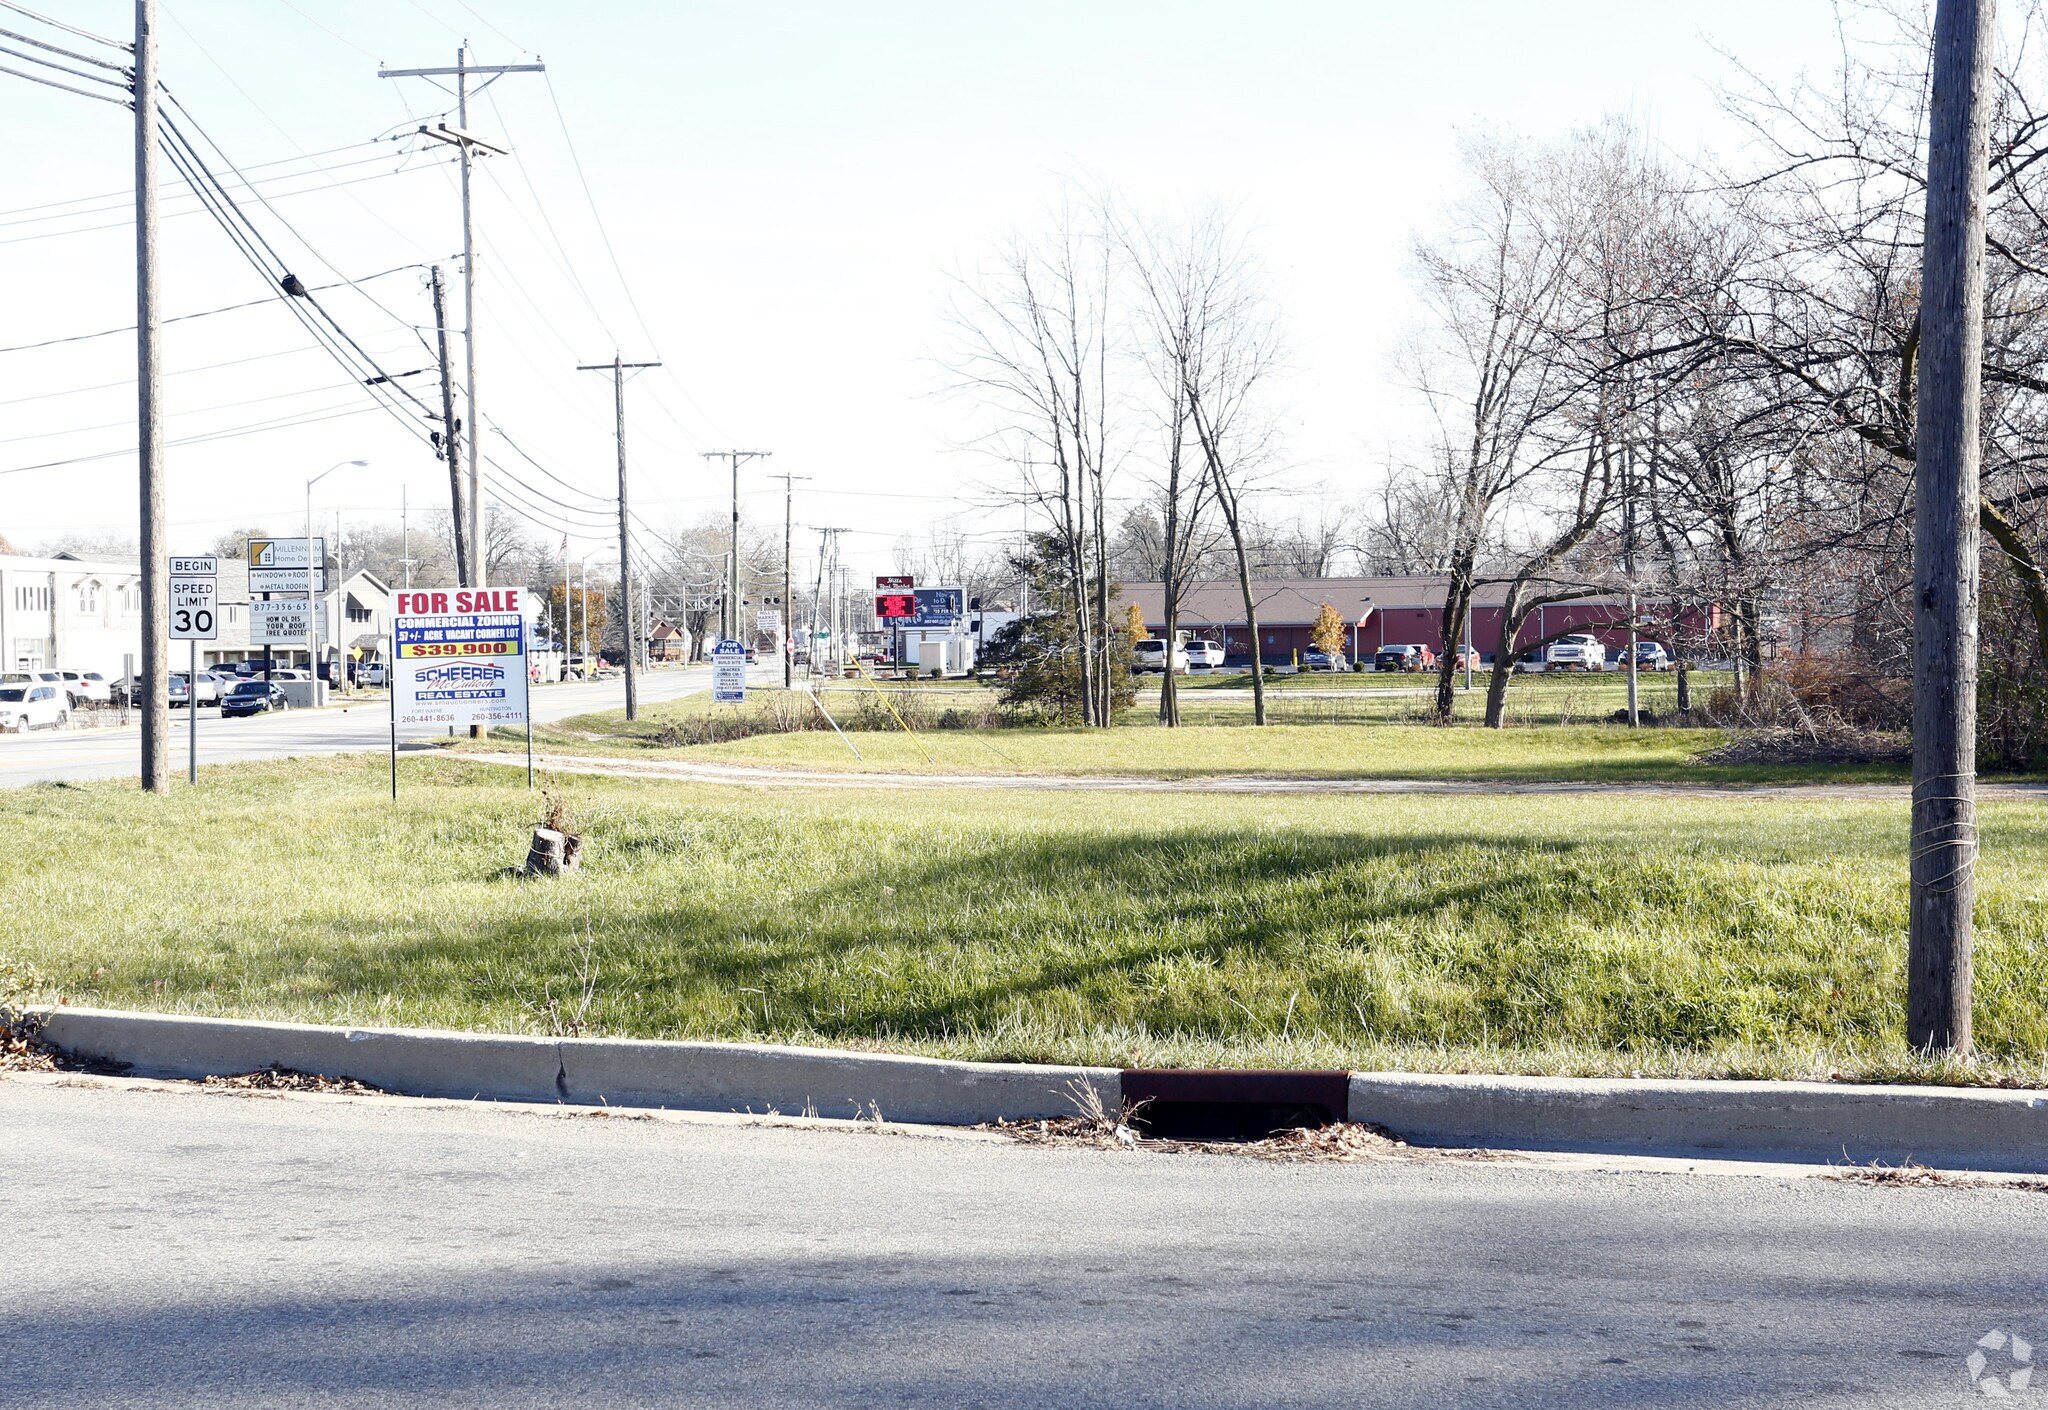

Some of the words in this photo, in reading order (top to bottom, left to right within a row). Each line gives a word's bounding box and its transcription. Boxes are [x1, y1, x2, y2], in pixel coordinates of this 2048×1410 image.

[297, 555, 322, 563] Degn
[175, 561, 212, 571] BEGIN
[173, 584, 213, 594] SPEED
[177, 597, 209, 606] LIMIT
[254, 603, 319, 611] 877-356-656
[397, 592, 448, 615] FOR
[455, 590, 519, 613] SALE
[174, 610, 213, 632] 30
[397, 616, 475, 629] COMMERCIAL
[476, 615, 520, 627] ZONING
[397, 631, 409, 642] .57
[409, 631, 422, 641] +/-
[423, 630, 444, 641] ACRE
[446, 629, 475, 640] VACANT
[475, 629, 505, 639] CORNER
[506, 628, 519, 638] LOT
[412, 643, 507, 657] $39,900
[414, 666, 505, 682] SCHEERER
[426, 677, 495, 690] McCulloch
[417, 691, 452, 700] REAL
[454, 689, 503, 699] ESTATE
[415, 698, 507, 706] www.smauctioneers.com
[402, 714, 455, 723] 260-441-8636
[472, 712, 523, 721] 260-356-4111
